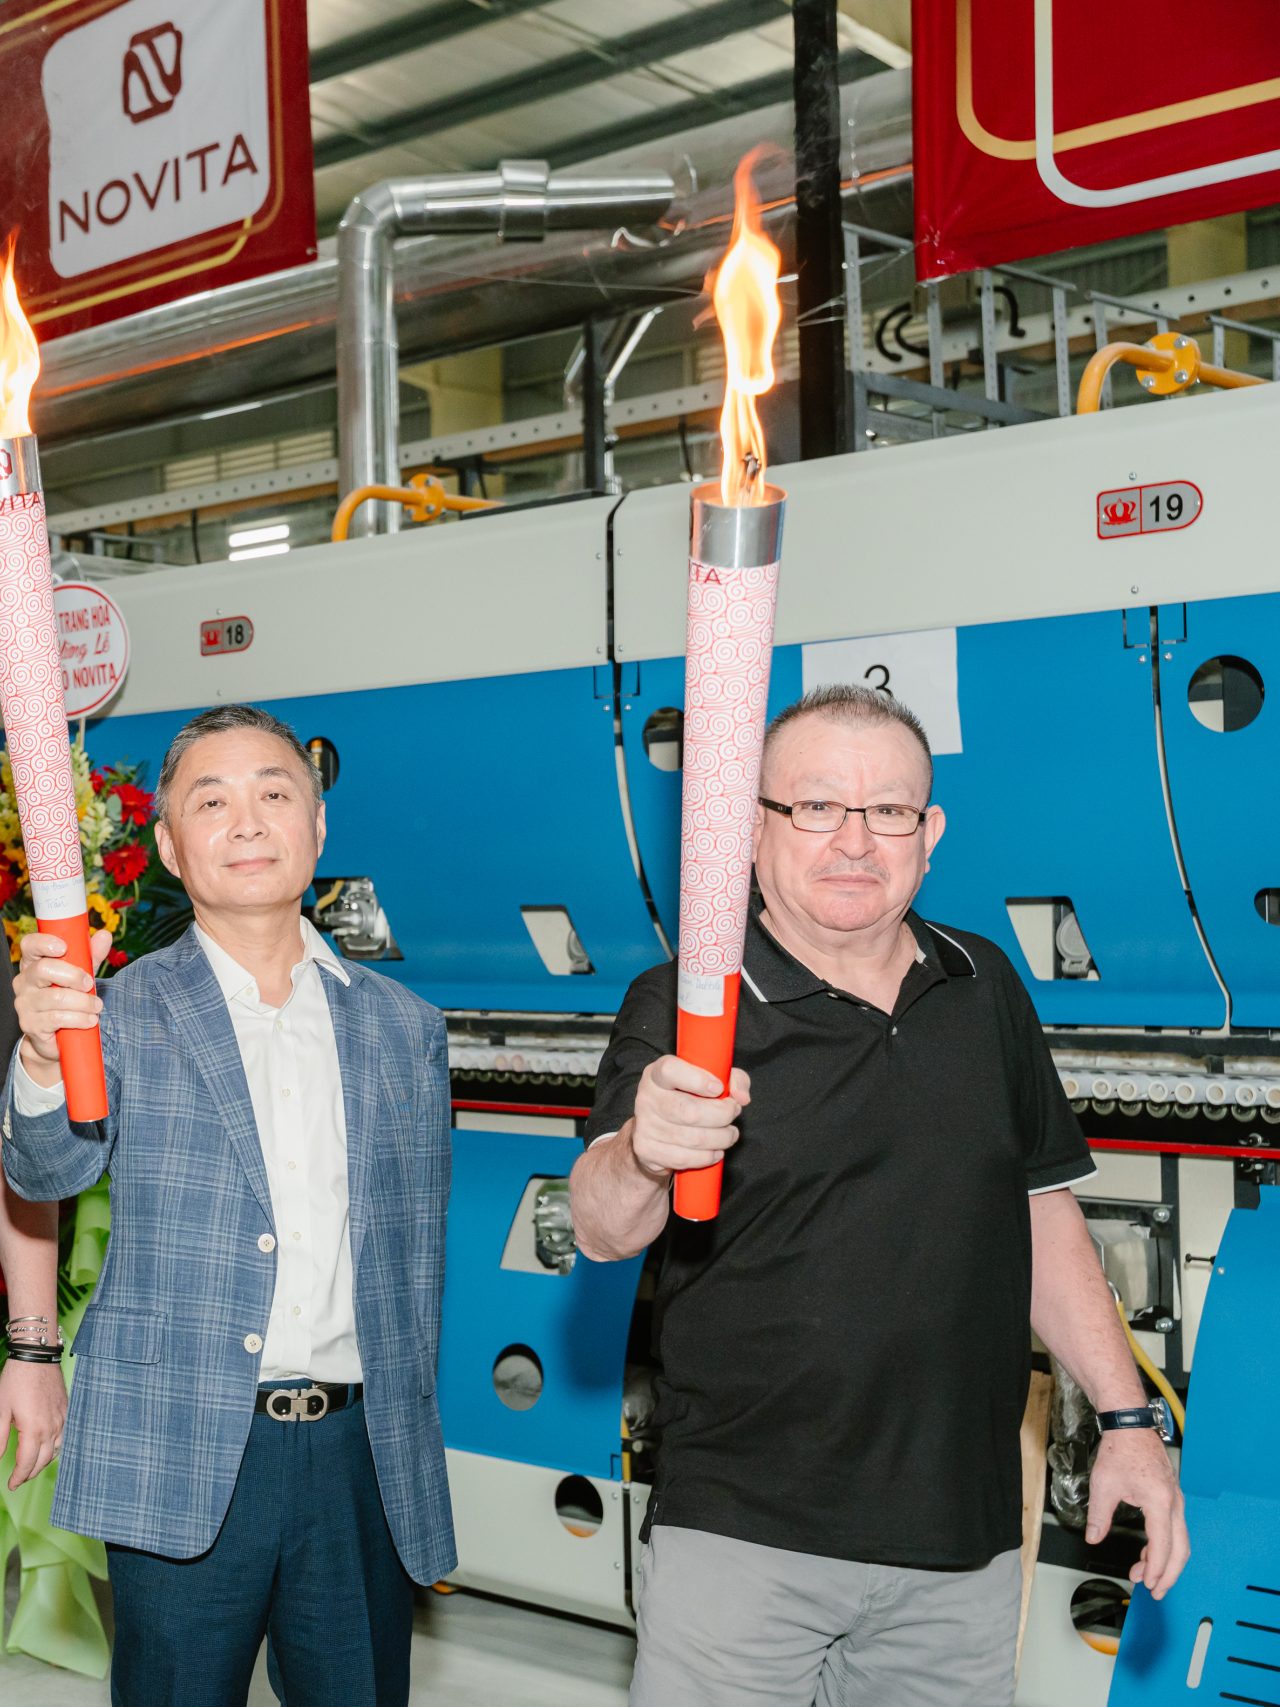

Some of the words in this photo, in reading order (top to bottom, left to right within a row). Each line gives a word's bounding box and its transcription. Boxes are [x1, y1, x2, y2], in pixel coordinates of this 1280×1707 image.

[58, 132, 259, 243] NOVITA
[1149, 493, 1184, 523] 19
[226, 623, 245, 646] 18
[72, 661, 117, 689] NOVITA
